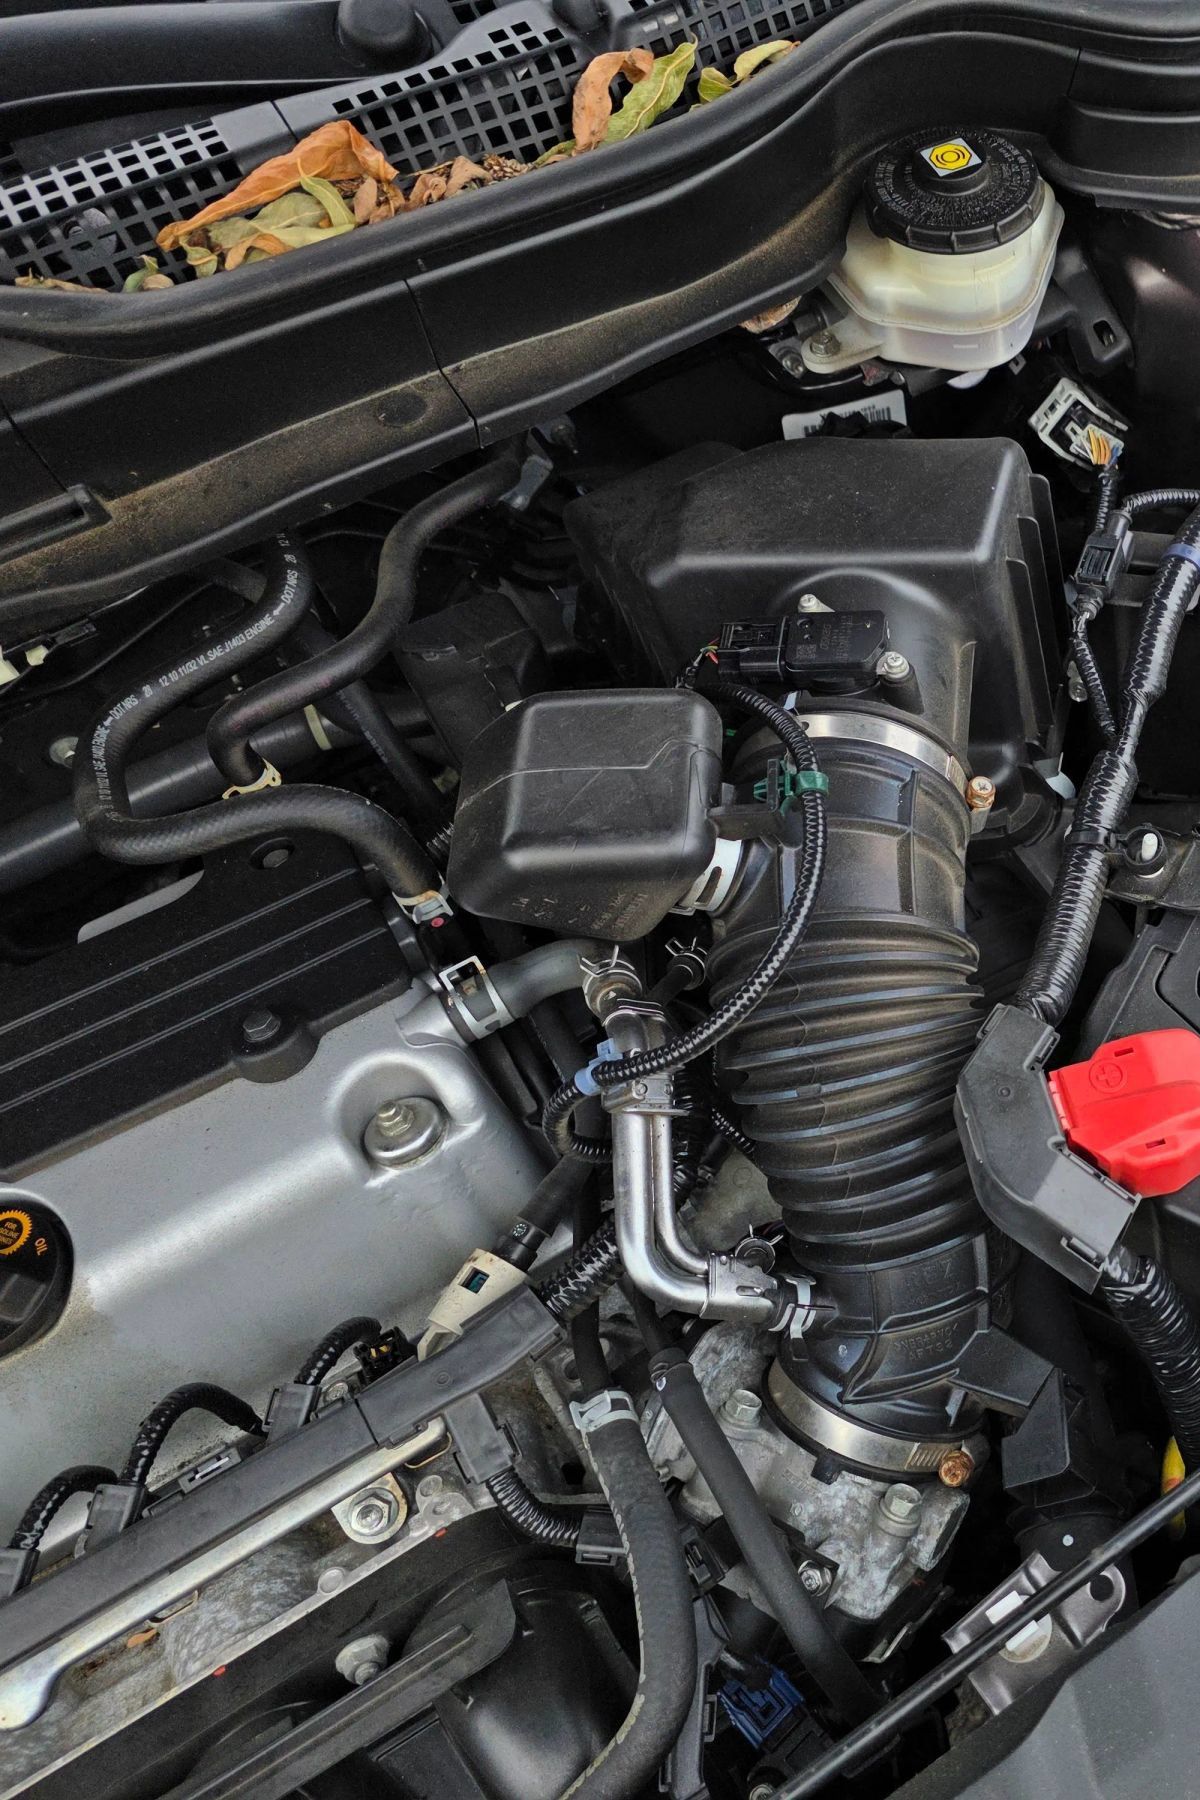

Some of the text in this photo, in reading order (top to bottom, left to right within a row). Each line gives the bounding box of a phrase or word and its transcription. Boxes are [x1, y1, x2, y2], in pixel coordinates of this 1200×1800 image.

[281, 582, 295, 604] DOT
[109, 704, 126, 719] DOT
[121, 695, 139, 710] NRS
[159, 675, 170, 687] 12
[168, 670, 179, 682] 10
[207, 645, 224, 661] SAE
[224, 633, 246, 653] J1403
[244, 614, 275, 639] ENGINE
[34, 1237, 48, 1256] OIL
